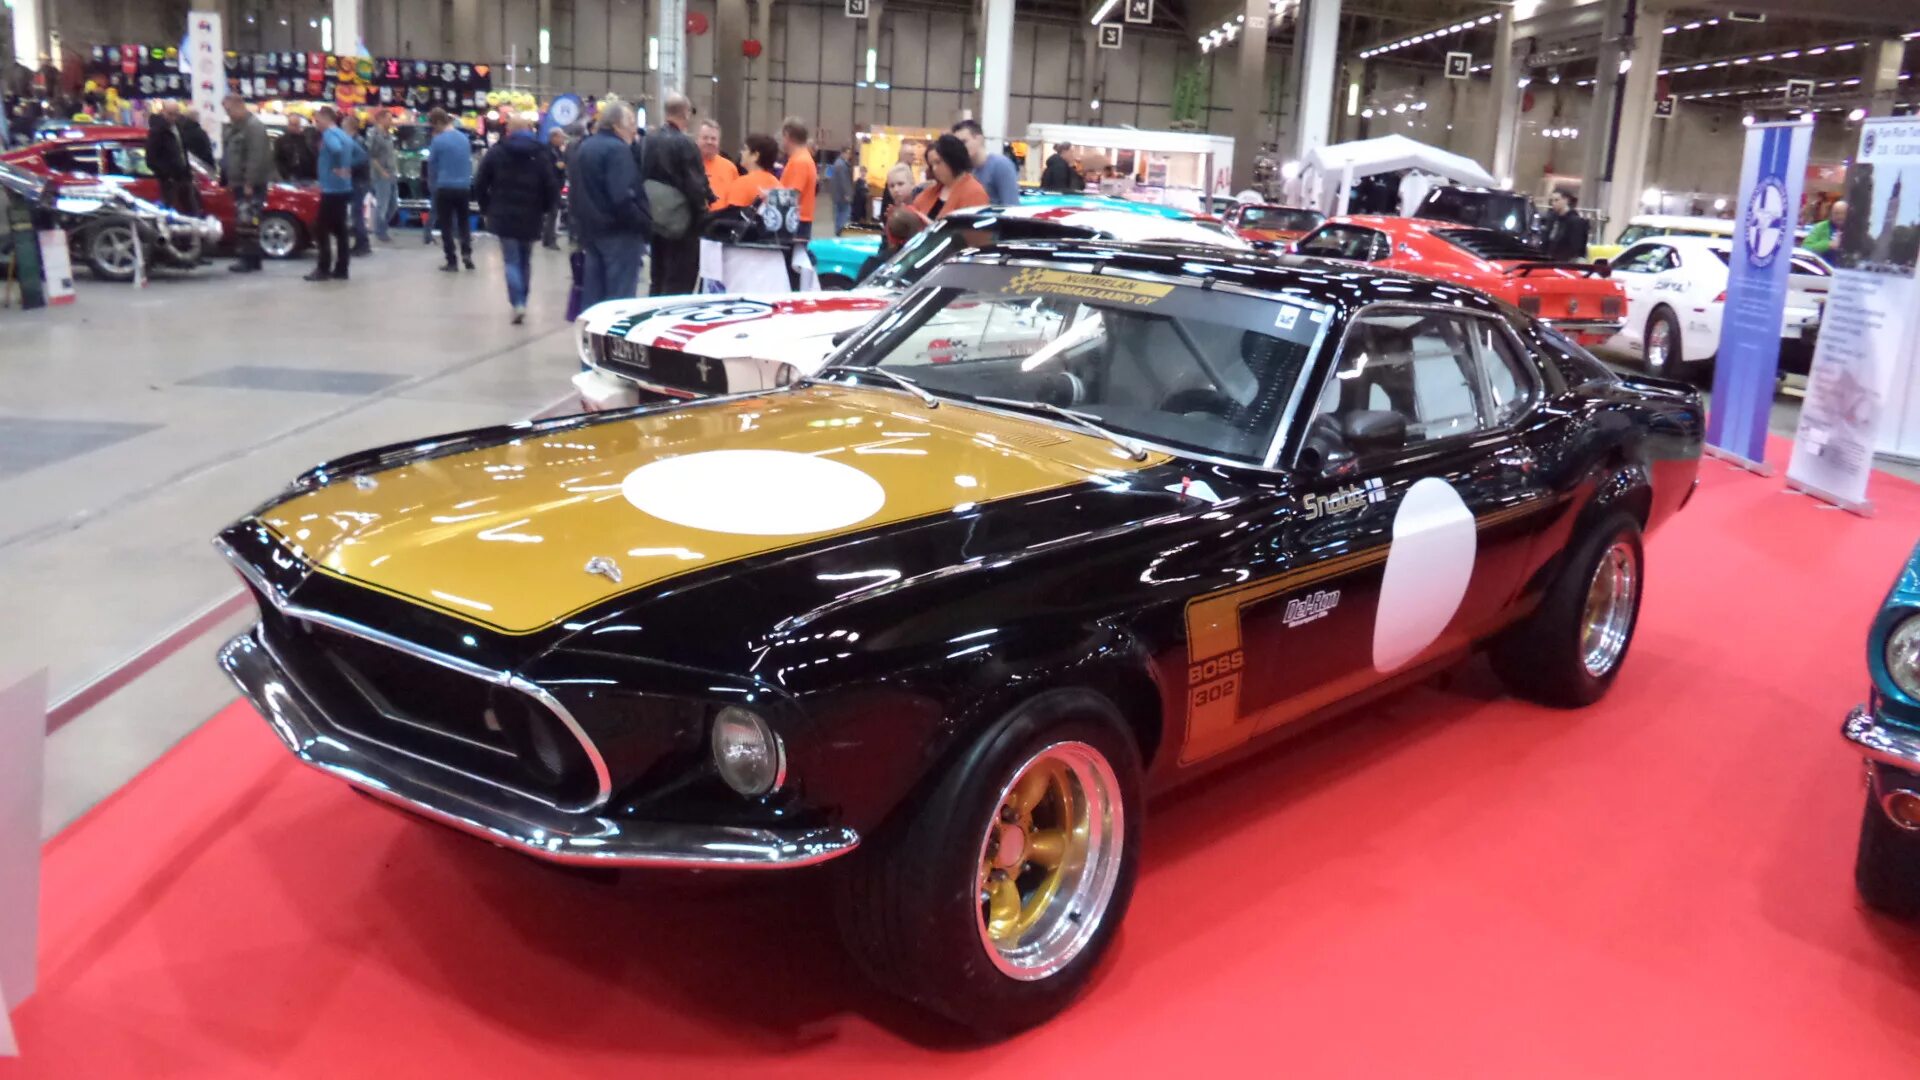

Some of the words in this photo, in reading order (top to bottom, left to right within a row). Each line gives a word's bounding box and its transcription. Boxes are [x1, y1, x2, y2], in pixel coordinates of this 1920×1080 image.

[1063, 274, 1137, 290] NUMMELAN
[1188, 651, 1244, 685] BOSS
[1195, 681, 1234, 707] 302
